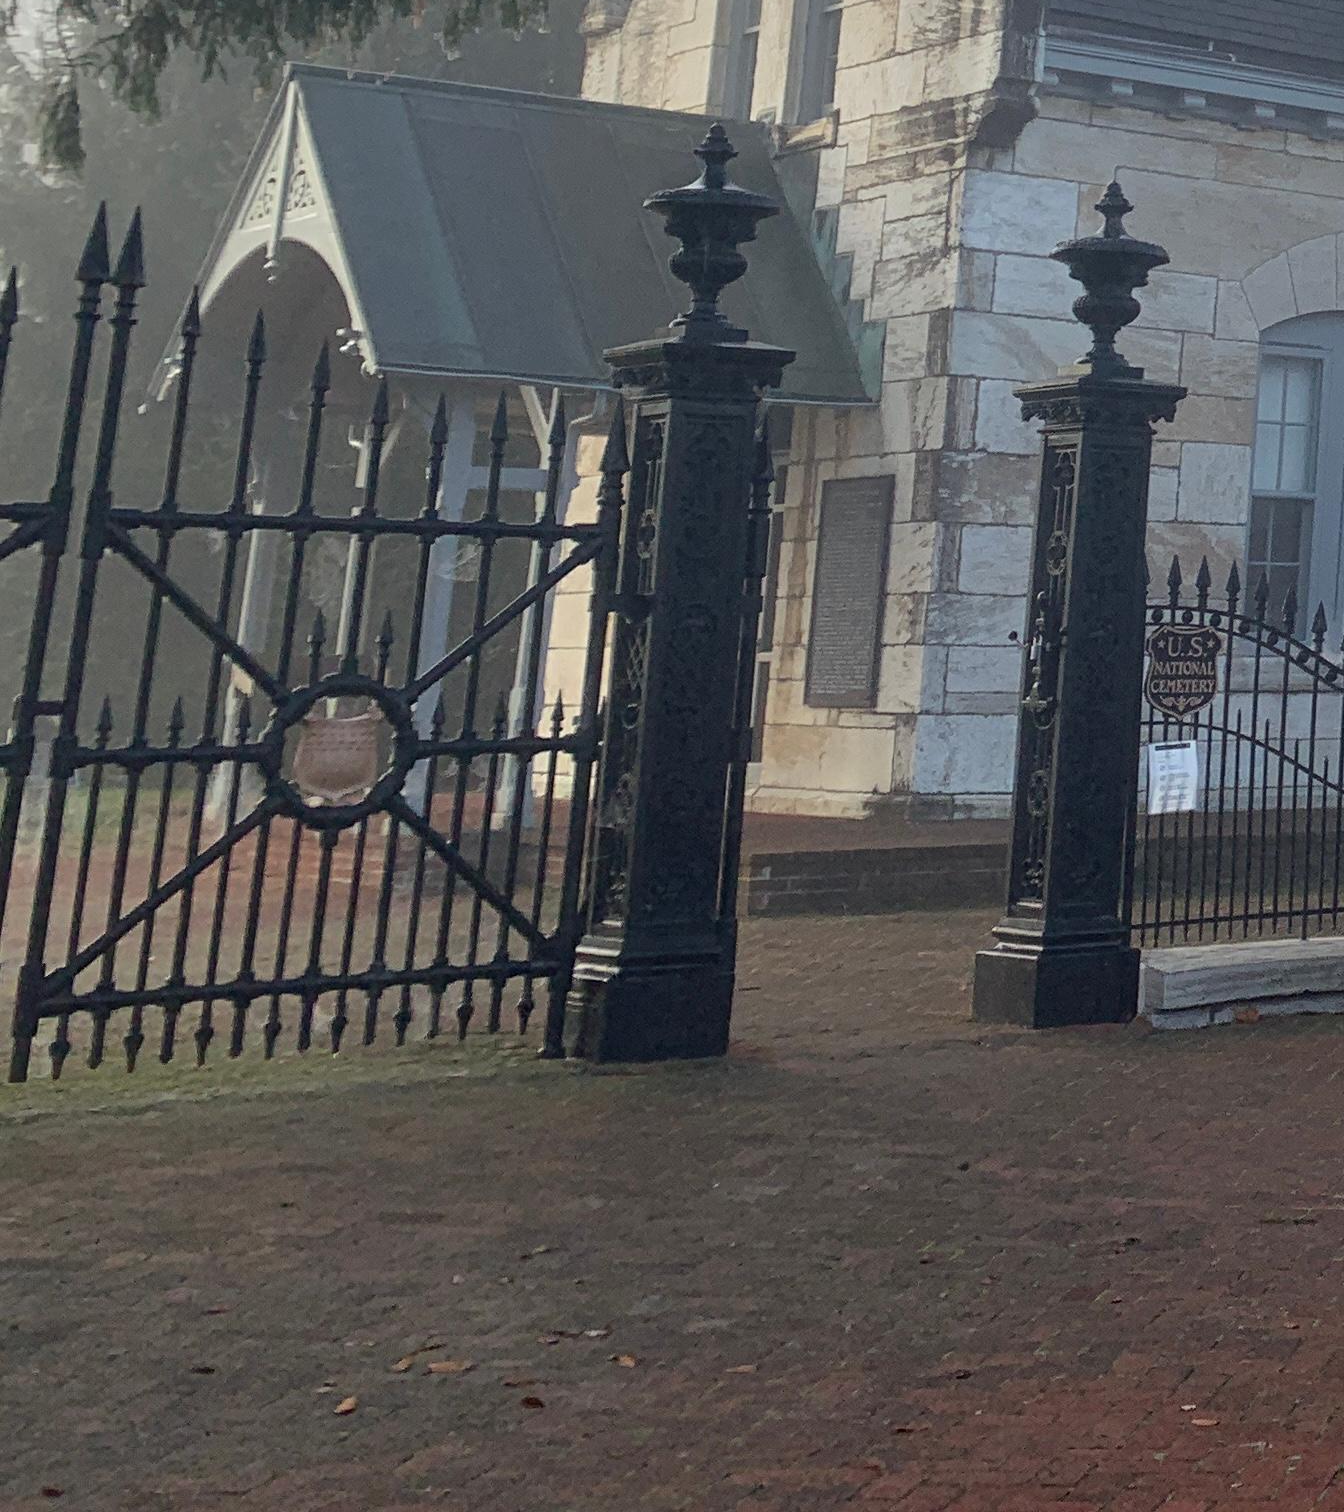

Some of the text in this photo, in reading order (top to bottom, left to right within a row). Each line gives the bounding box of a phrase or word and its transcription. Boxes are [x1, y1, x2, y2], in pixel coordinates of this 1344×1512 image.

[1167, 637, 1207, 657] U.S.
[1153, 661, 1215, 676] NATIONAL
[1151, 678, 1216, 693] CEMETERY
